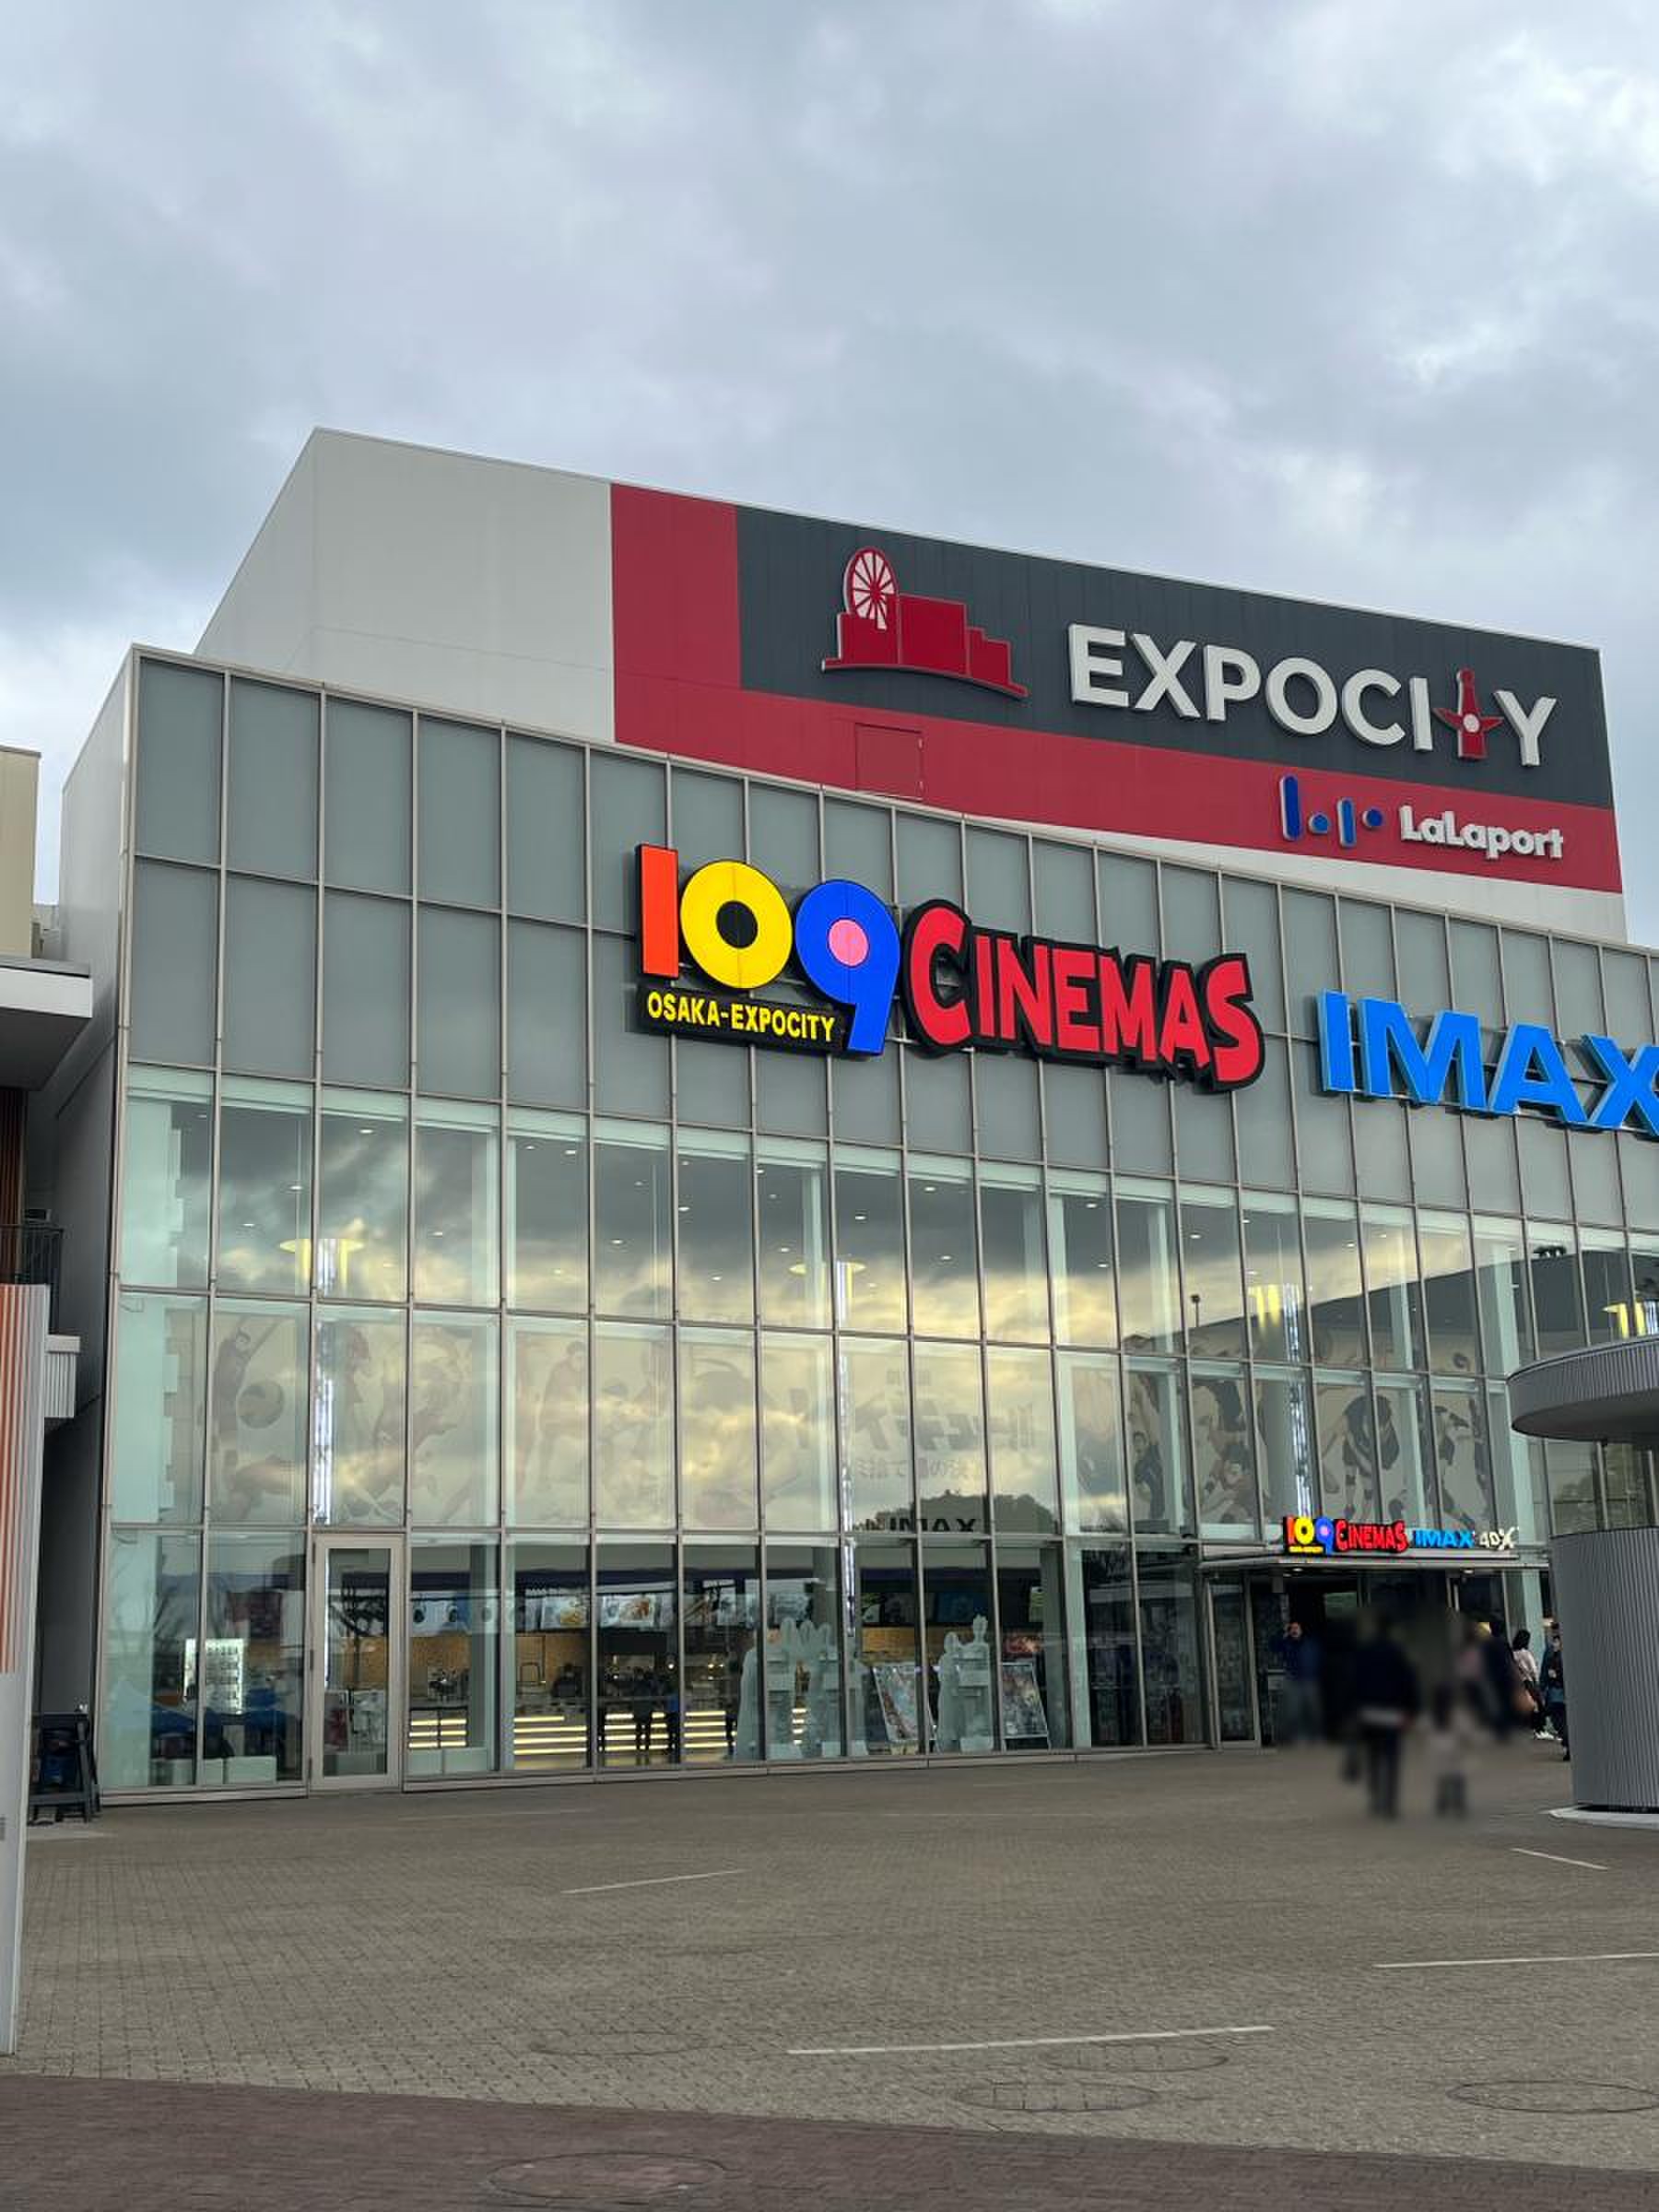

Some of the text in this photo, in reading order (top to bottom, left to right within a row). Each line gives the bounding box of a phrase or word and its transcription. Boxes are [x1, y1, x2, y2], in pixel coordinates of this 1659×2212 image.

[1399, 805, 1564, 860] LaLaport
[637, 843, 1263, 1087] 109 CINEMAS
[648, 991, 835, 1042] OSAKA-EXPOCITY
[1318, 989, 1659, 1136] IMAX
[1287, 1515, 1335, 1555] 109
[1335, 1519, 1408, 1553] CINEMAS
[1415, 1528, 1473, 1549] IMAX
